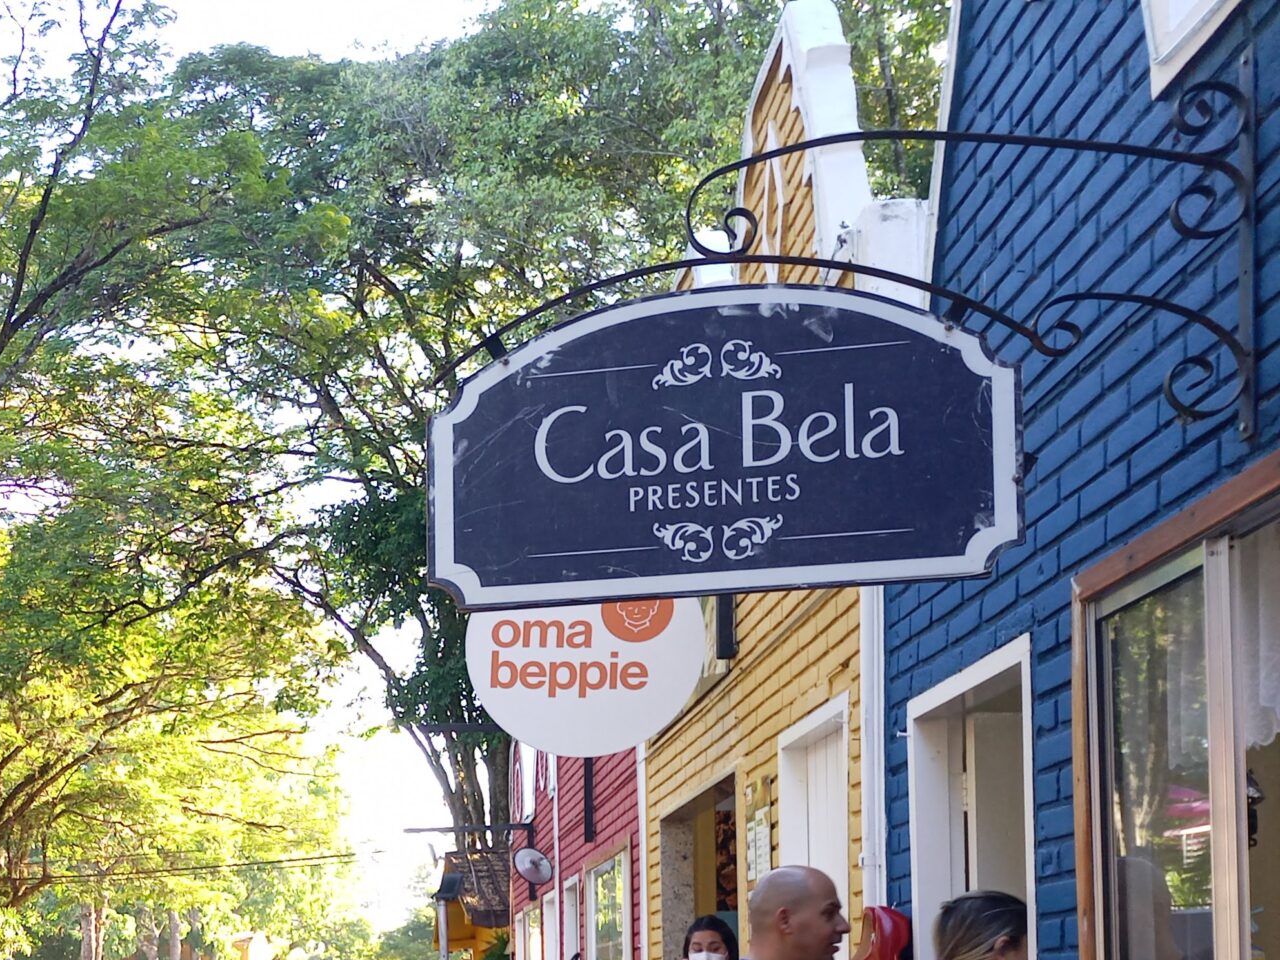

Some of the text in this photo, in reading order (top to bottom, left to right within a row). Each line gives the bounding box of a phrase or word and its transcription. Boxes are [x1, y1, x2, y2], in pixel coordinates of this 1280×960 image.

[533, 382, 905, 484] Casa Bela
[628, 473, 801, 512] PRESENTES
[490, 618, 593, 649] oma
[489, 651, 649, 699] beppie
